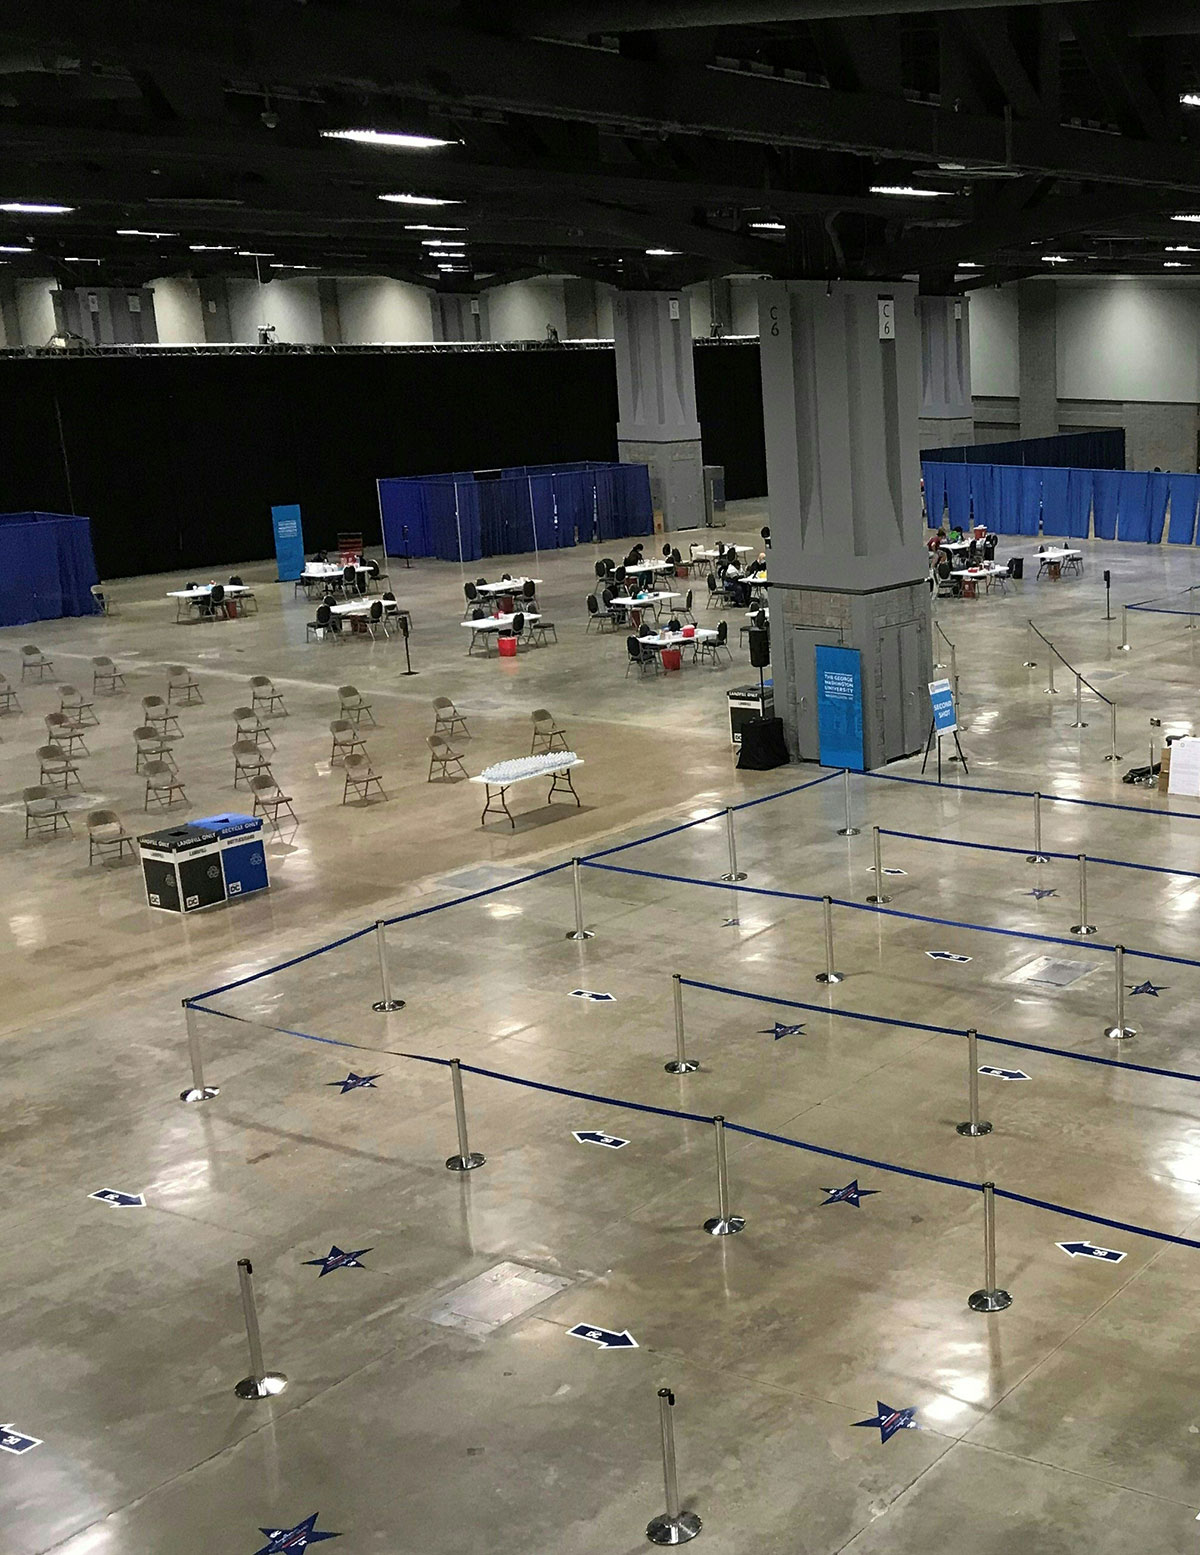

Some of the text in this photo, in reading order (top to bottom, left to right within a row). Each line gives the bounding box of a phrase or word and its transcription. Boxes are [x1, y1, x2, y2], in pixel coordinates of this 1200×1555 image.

[770, 306, 778, 320] C
[883, 304, 890, 318] C
[771, 322, 779, 336] 6
[884, 321, 890, 335] 6
[933, 700, 952, 711] SECOND
[938, 709, 951, 719] SHOT
[221, 821, 259, 834] RECYCLE ONLY
[177, 836, 201, 848] LANDFILL
[202, 832, 216, 841] ONLY
[230, 884, 241, 893] DC
